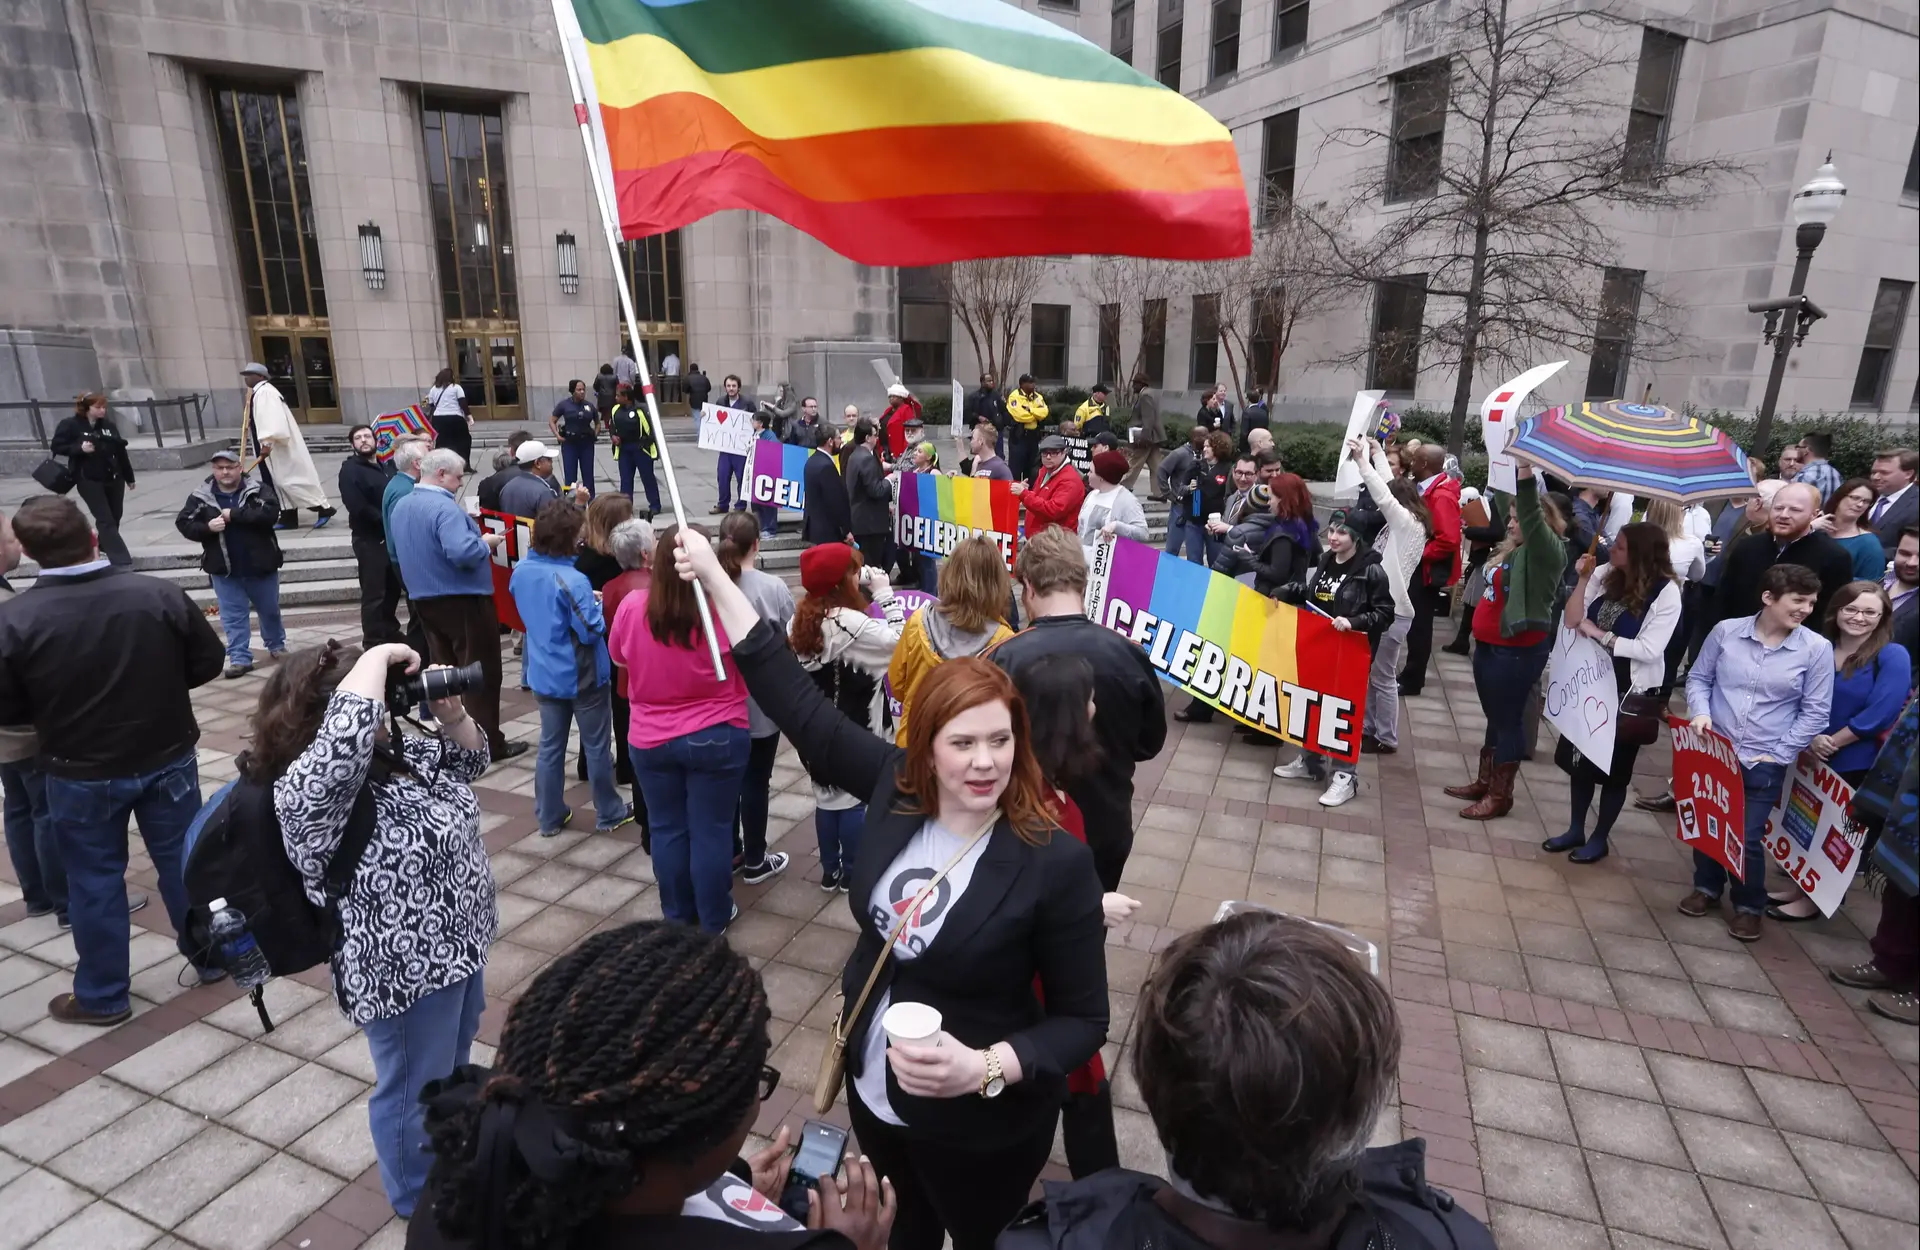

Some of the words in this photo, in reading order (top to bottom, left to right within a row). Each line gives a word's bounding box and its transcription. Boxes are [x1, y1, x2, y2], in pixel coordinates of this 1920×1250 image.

[1075, 438, 1088, 448] HAVE
[1106, 598, 1355, 754] CELEBRATE
[1691, 771, 1730, 814] 2.9.15
